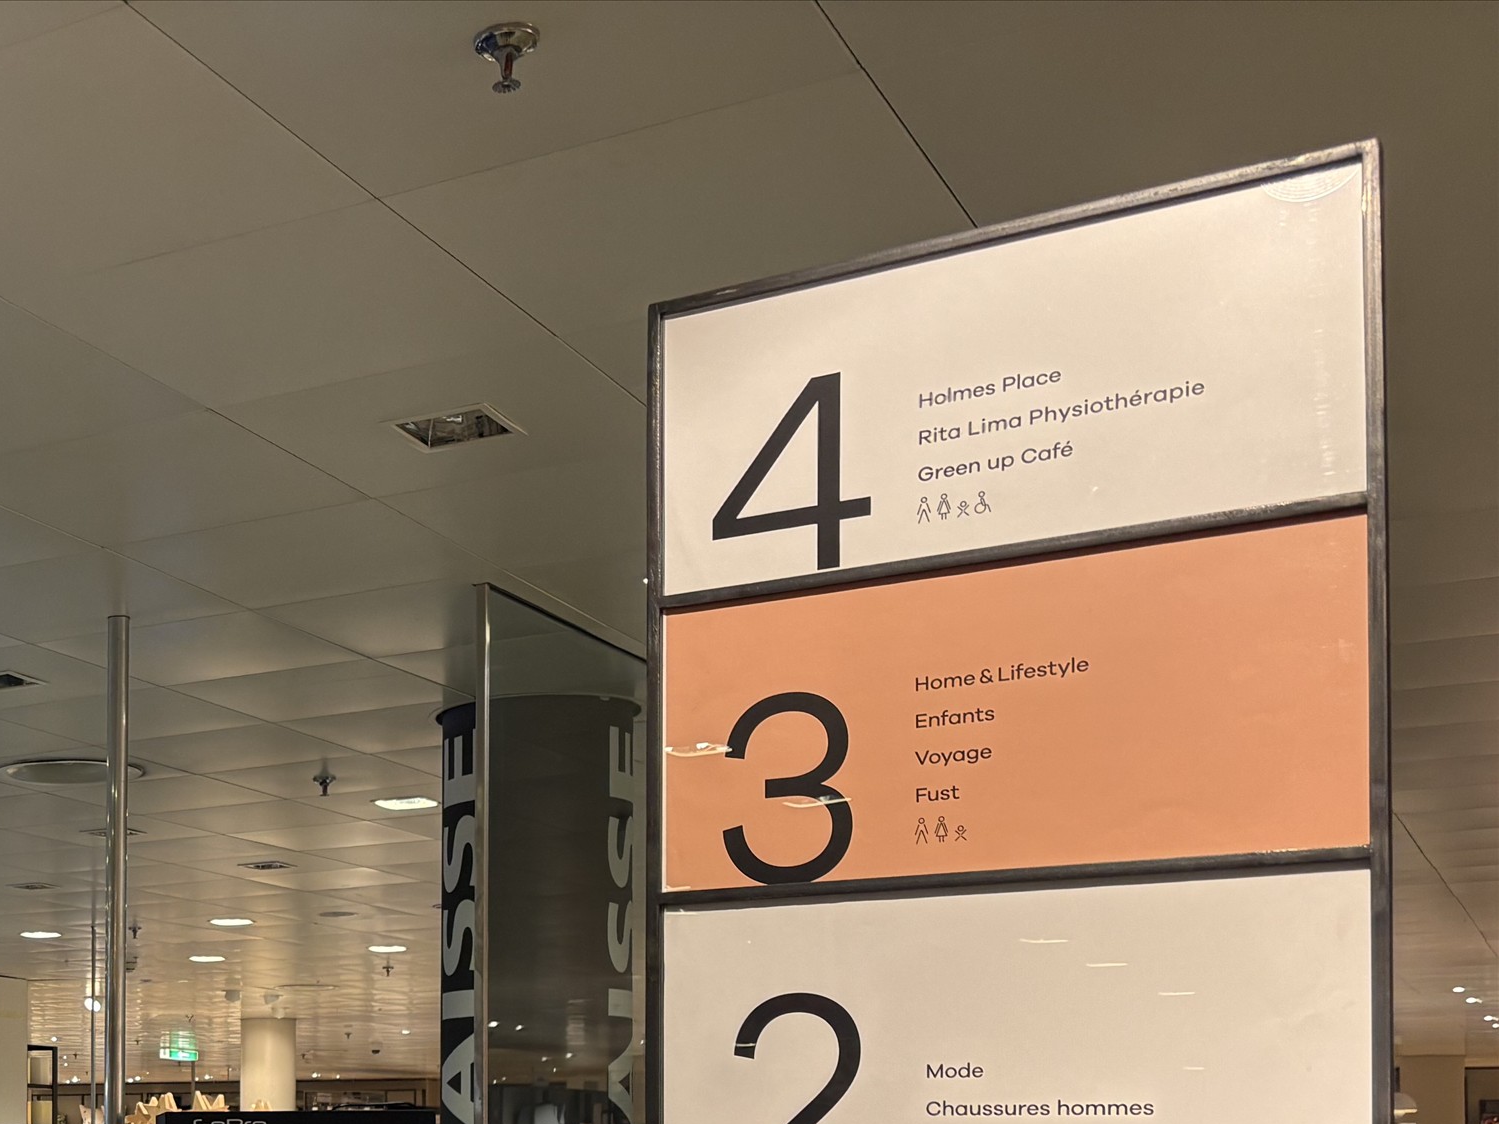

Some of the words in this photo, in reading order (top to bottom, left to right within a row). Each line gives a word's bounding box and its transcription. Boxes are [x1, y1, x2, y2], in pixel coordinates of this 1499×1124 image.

[918, 383, 996, 409] Holmes
[1002, 370, 1062, 393] Place
[918, 426, 961, 446] Rita
[968, 415, 1022, 437] Lima
[1029, 380, 1205, 426] Physiothérapie
[711, 371, 872, 571] 4
[917, 460, 981, 482] Green
[987, 455, 1015, 472] up
[1020, 440, 1074, 464] Café
[915, 673, 976, 692] Home
[979, 668, 994, 684] &
[998, 656, 1089, 682] Lifestyle
[915, 707, 995, 729] Enfants
[914, 747, 993, 767] Voyage
[722, 691, 854, 885] 3
[915, 785, 960, 803] Fust
[926, 1061, 984, 1079] Mode
[925, 1099, 1051, 1117] Chaussures
[1057, 1099, 1155, 1116] hommes
